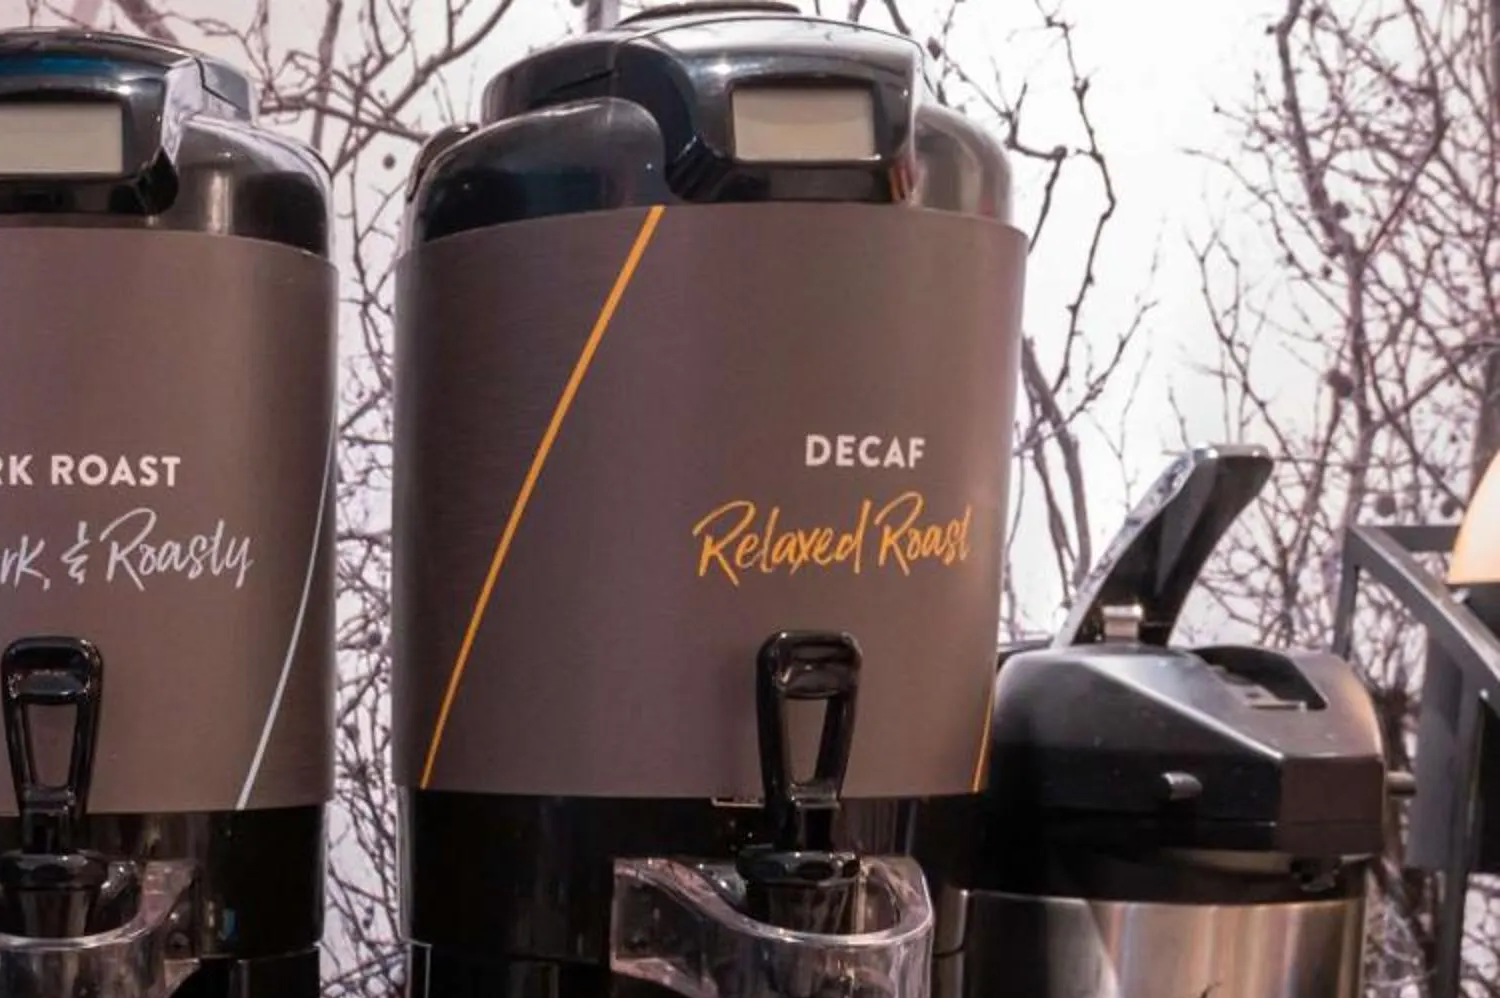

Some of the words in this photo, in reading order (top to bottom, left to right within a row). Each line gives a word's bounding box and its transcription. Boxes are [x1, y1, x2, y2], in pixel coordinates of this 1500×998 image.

[50, 454, 181, 487] ROAST
[805, 434, 925, 468] DECAF
[61, 520, 91, 584] &
[99, 508, 253, 591] Roasty
[692, 500, 872, 587] Relaxed
[874, 491, 972, 576] Roast
